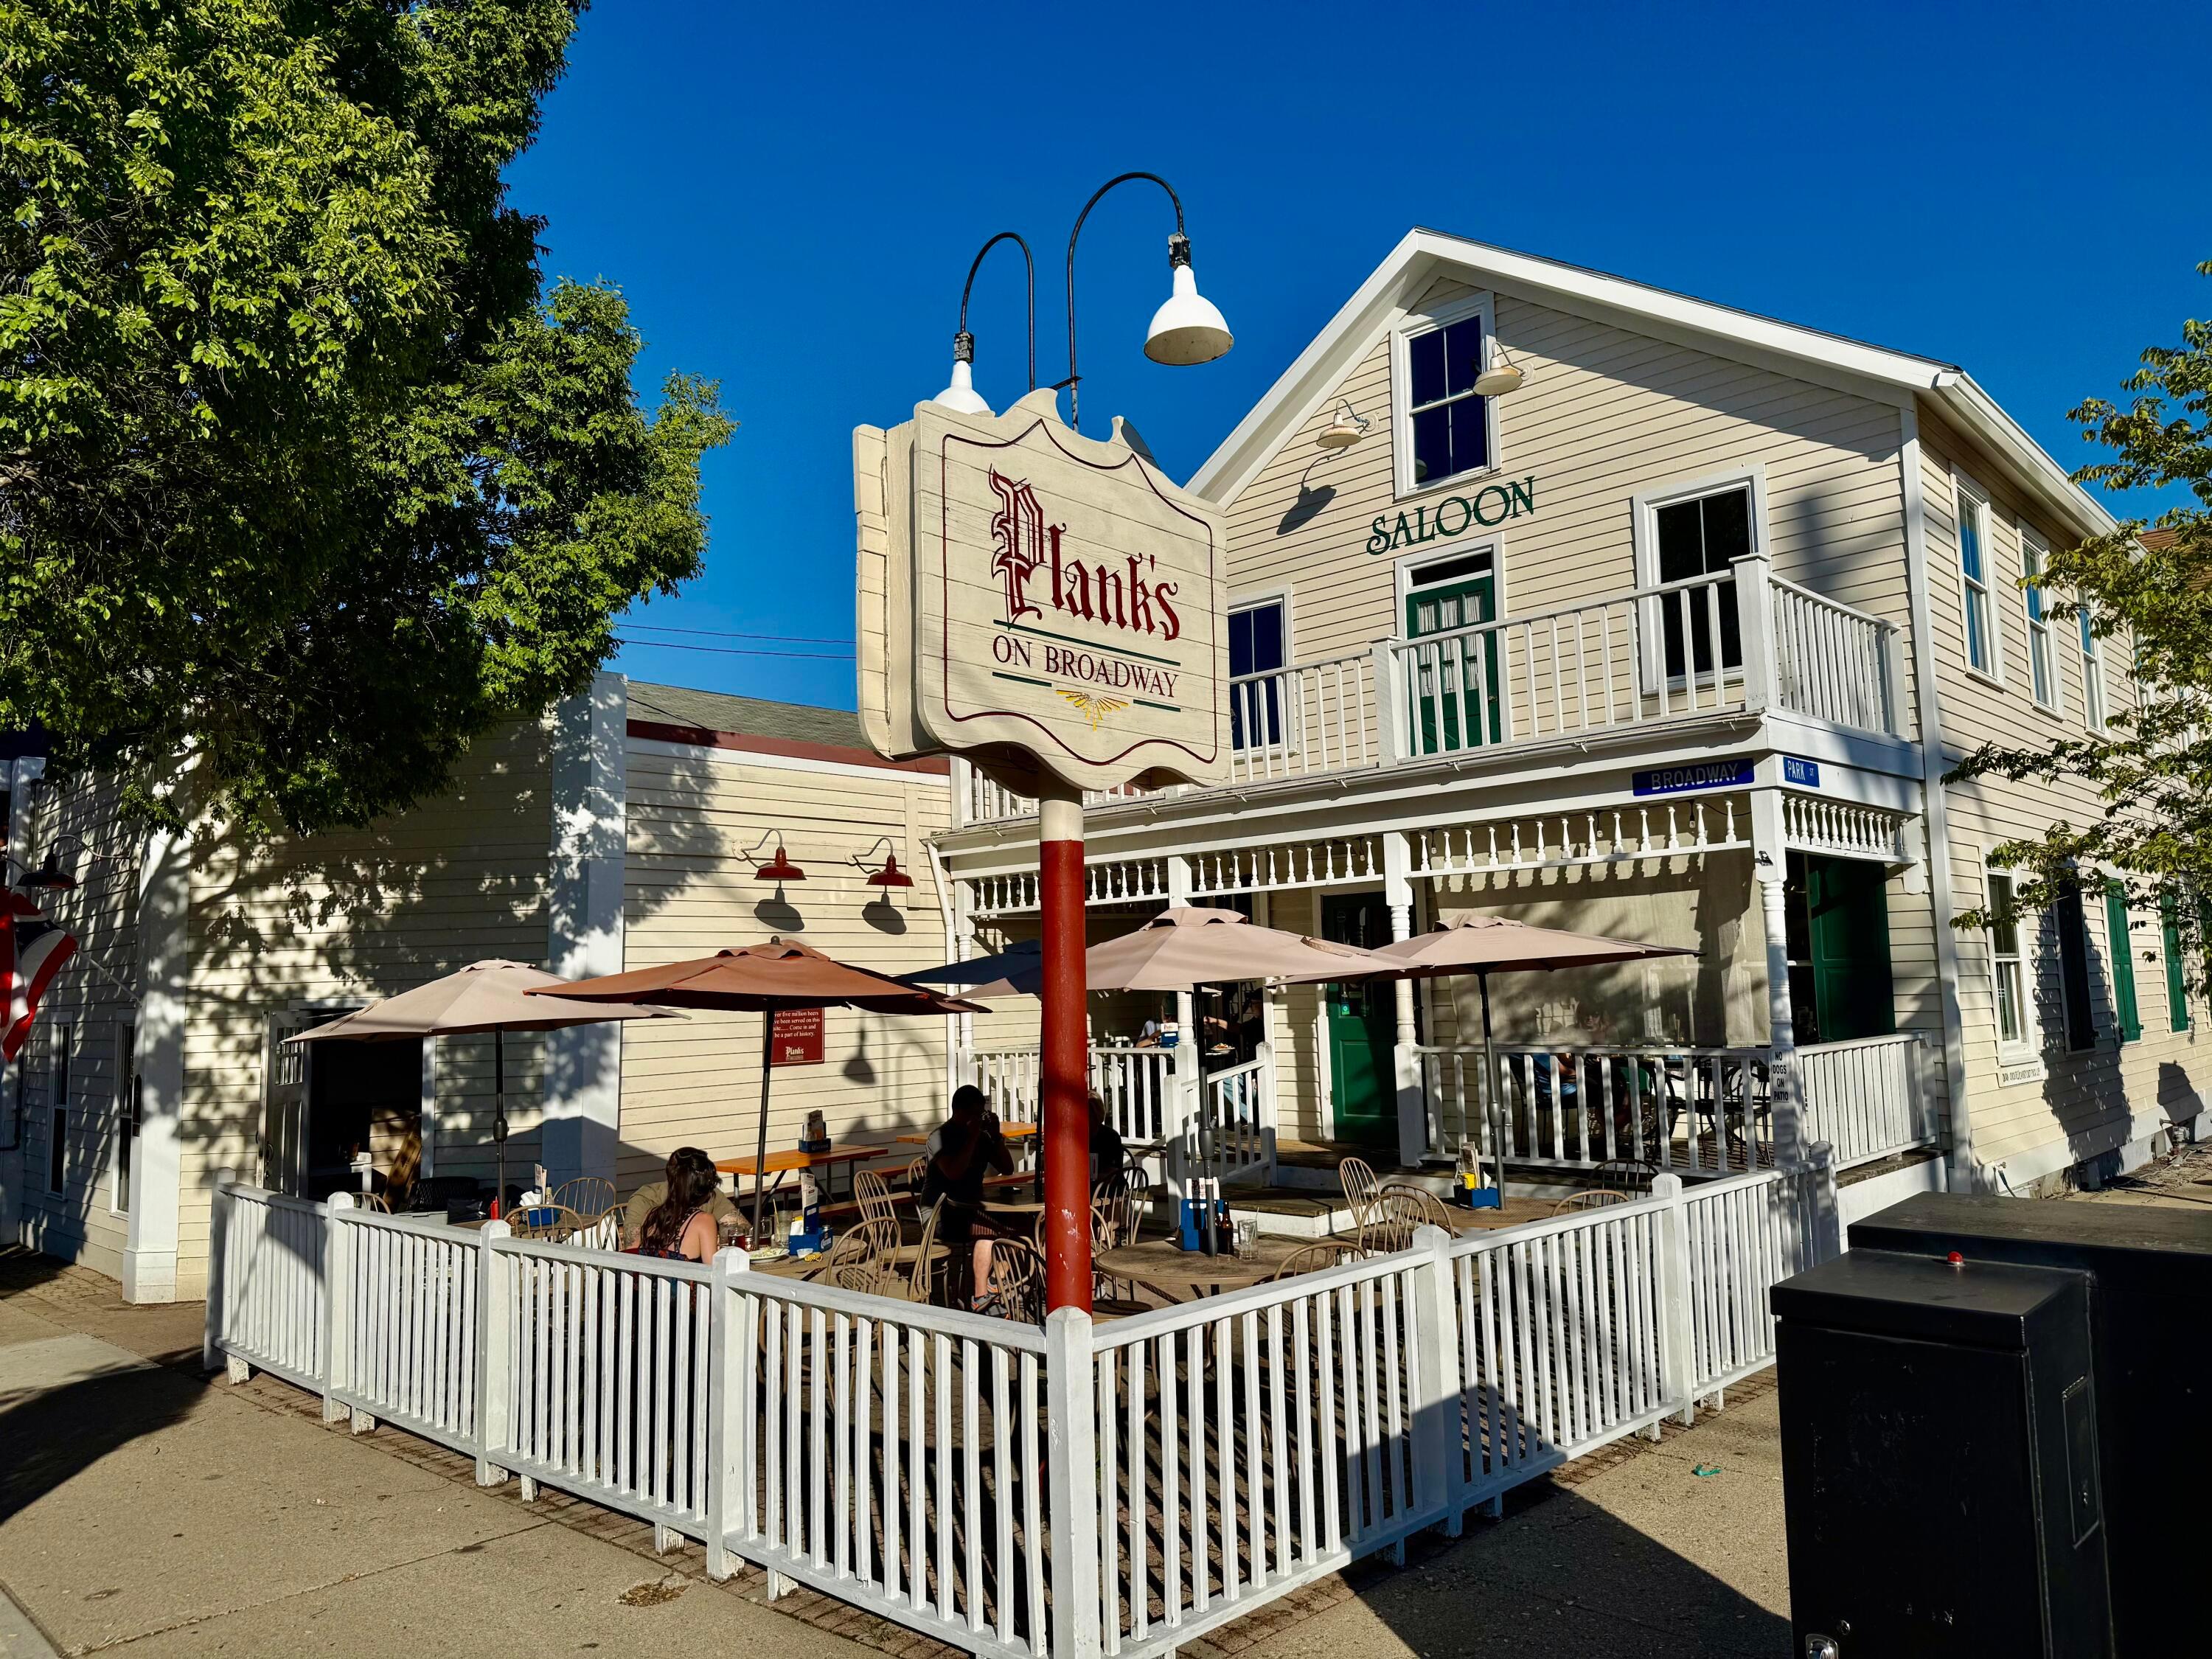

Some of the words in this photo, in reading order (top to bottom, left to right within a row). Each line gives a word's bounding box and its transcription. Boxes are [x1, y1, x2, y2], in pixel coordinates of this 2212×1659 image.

[1366, 476, 1536, 555] SALOON
[989, 463, 1180, 641] Plank's
[992, 634, 1032, 668] ON
[1045, 645, 1179, 698] BROADWAY
[1651, 762, 1739, 790] BROADWAY
[1787, 760, 1806, 781] PARK
[1809, 768, 1815, 777] ST
[1775, 1051, 1783, 1061] NO
[1773, 1065, 1787, 1074] DOGS
[1776, 1077, 1785, 1088] ON
[1773, 1091, 1789, 1101] PATIO
